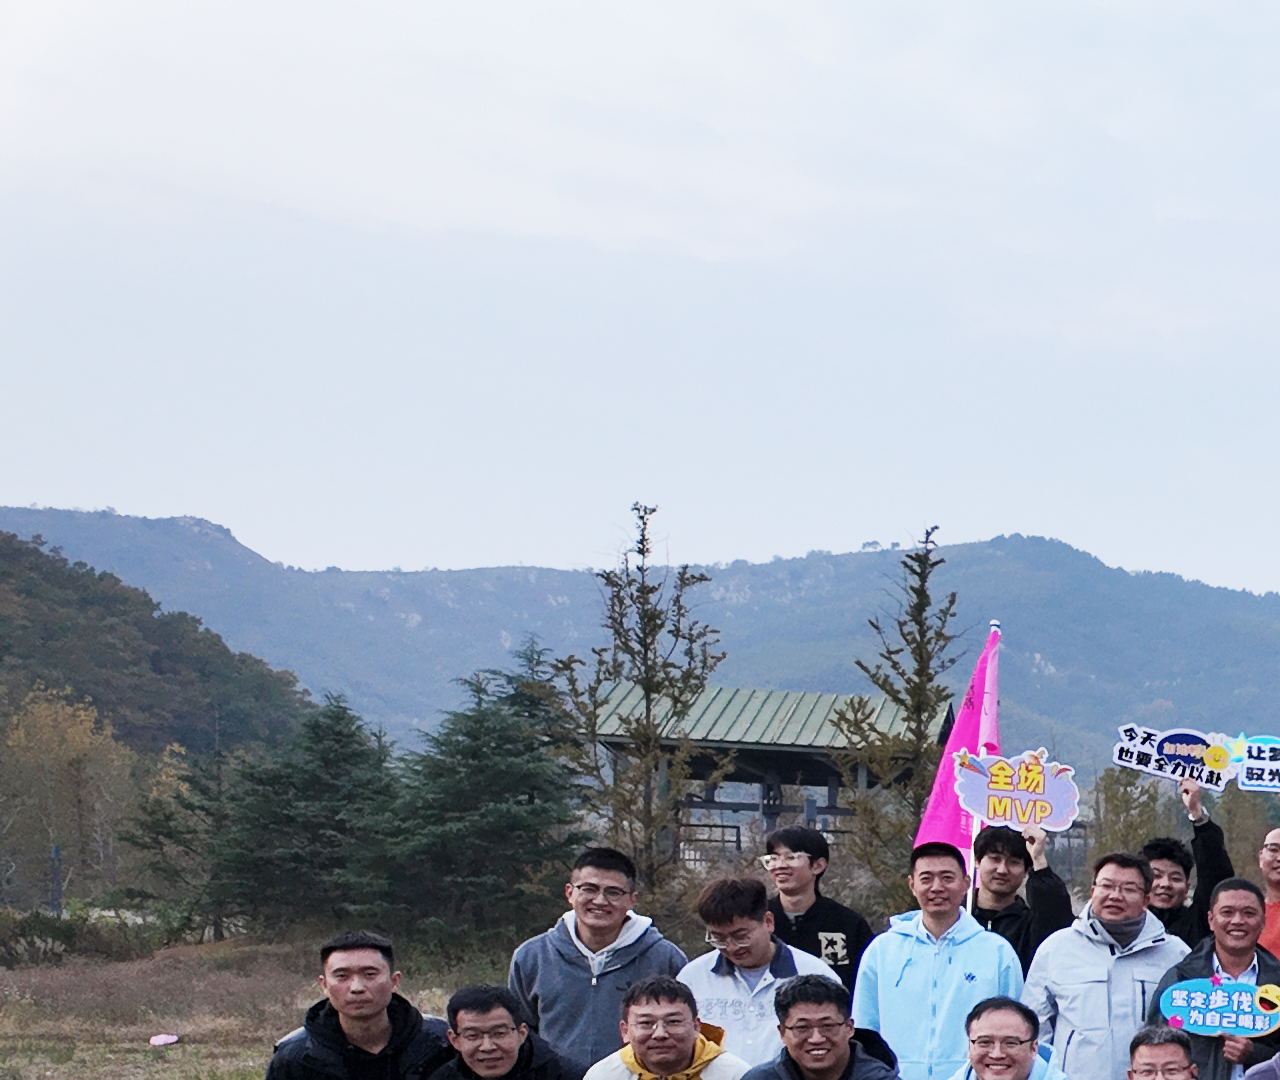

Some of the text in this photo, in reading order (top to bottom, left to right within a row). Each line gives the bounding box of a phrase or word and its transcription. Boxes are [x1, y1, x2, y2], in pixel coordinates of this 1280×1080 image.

[1123, 727, 1157, 748] 今天
[987, 759, 1045, 794] 全场
[1117, 746, 1222, 787] 也要全力以赴
[987, 795, 1053, 824] MVP
[1171, 989, 1253, 1012] 坚定步伐
[1189, 1009, 1270, 1030] 为自己喝彩
